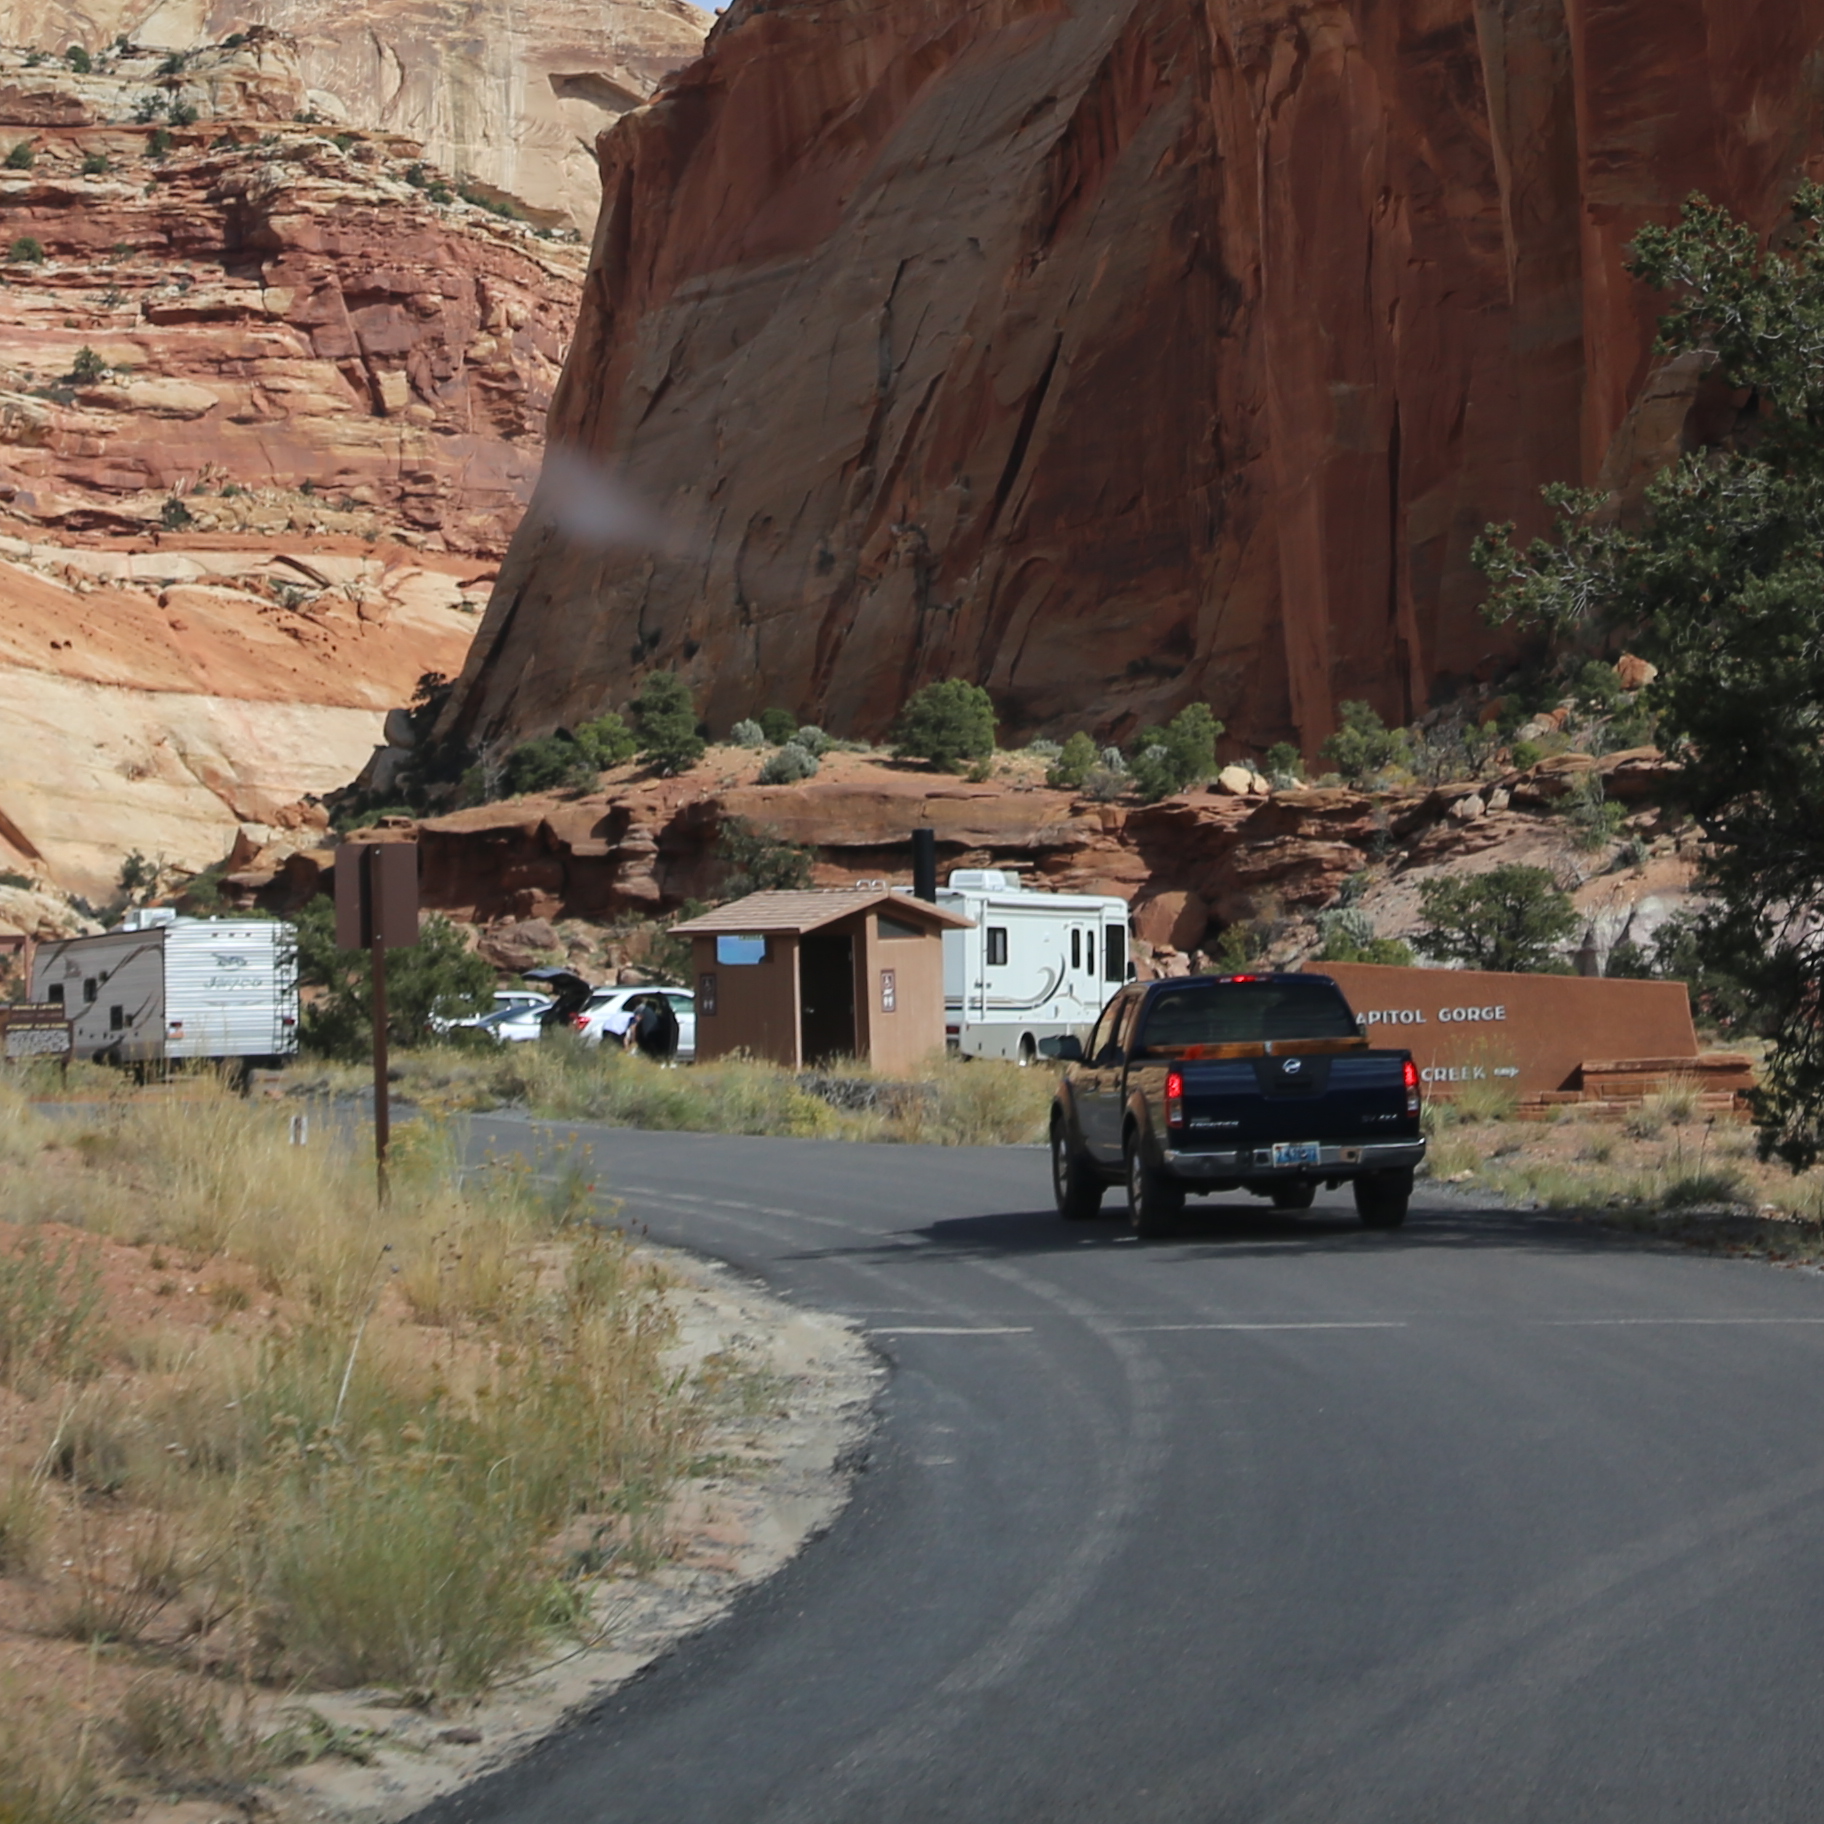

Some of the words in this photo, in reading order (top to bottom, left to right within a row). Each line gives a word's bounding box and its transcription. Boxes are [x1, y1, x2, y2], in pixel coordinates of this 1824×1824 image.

[1355, 1009, 1427, 1026] APITOL
[1438, 1005, 1507, 1023] GORGE
[1420, 1065, 1487, 1082] CREEK
